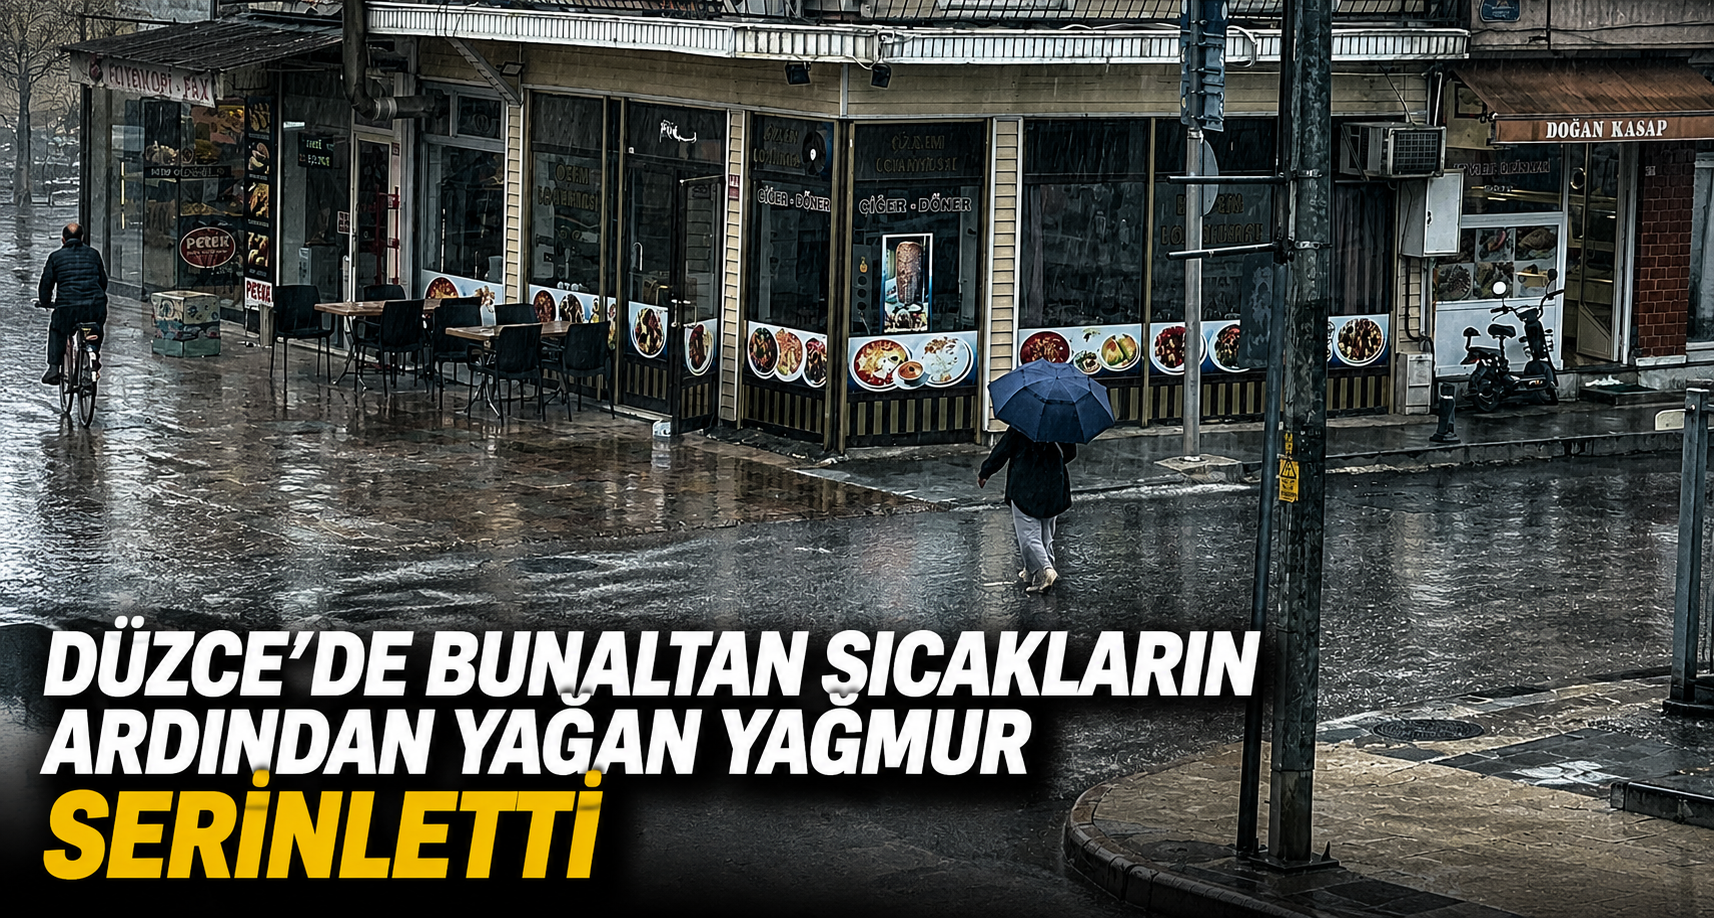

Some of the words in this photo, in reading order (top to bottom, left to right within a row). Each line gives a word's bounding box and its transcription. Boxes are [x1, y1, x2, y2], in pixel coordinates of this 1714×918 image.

[1545, 118, 1604, 139] DOĞAN
[1611, 119, 1668, 138] KASAP
[795, 190, 831, 212] DÖNER
[918, 193, 972, 212] DÖNER
